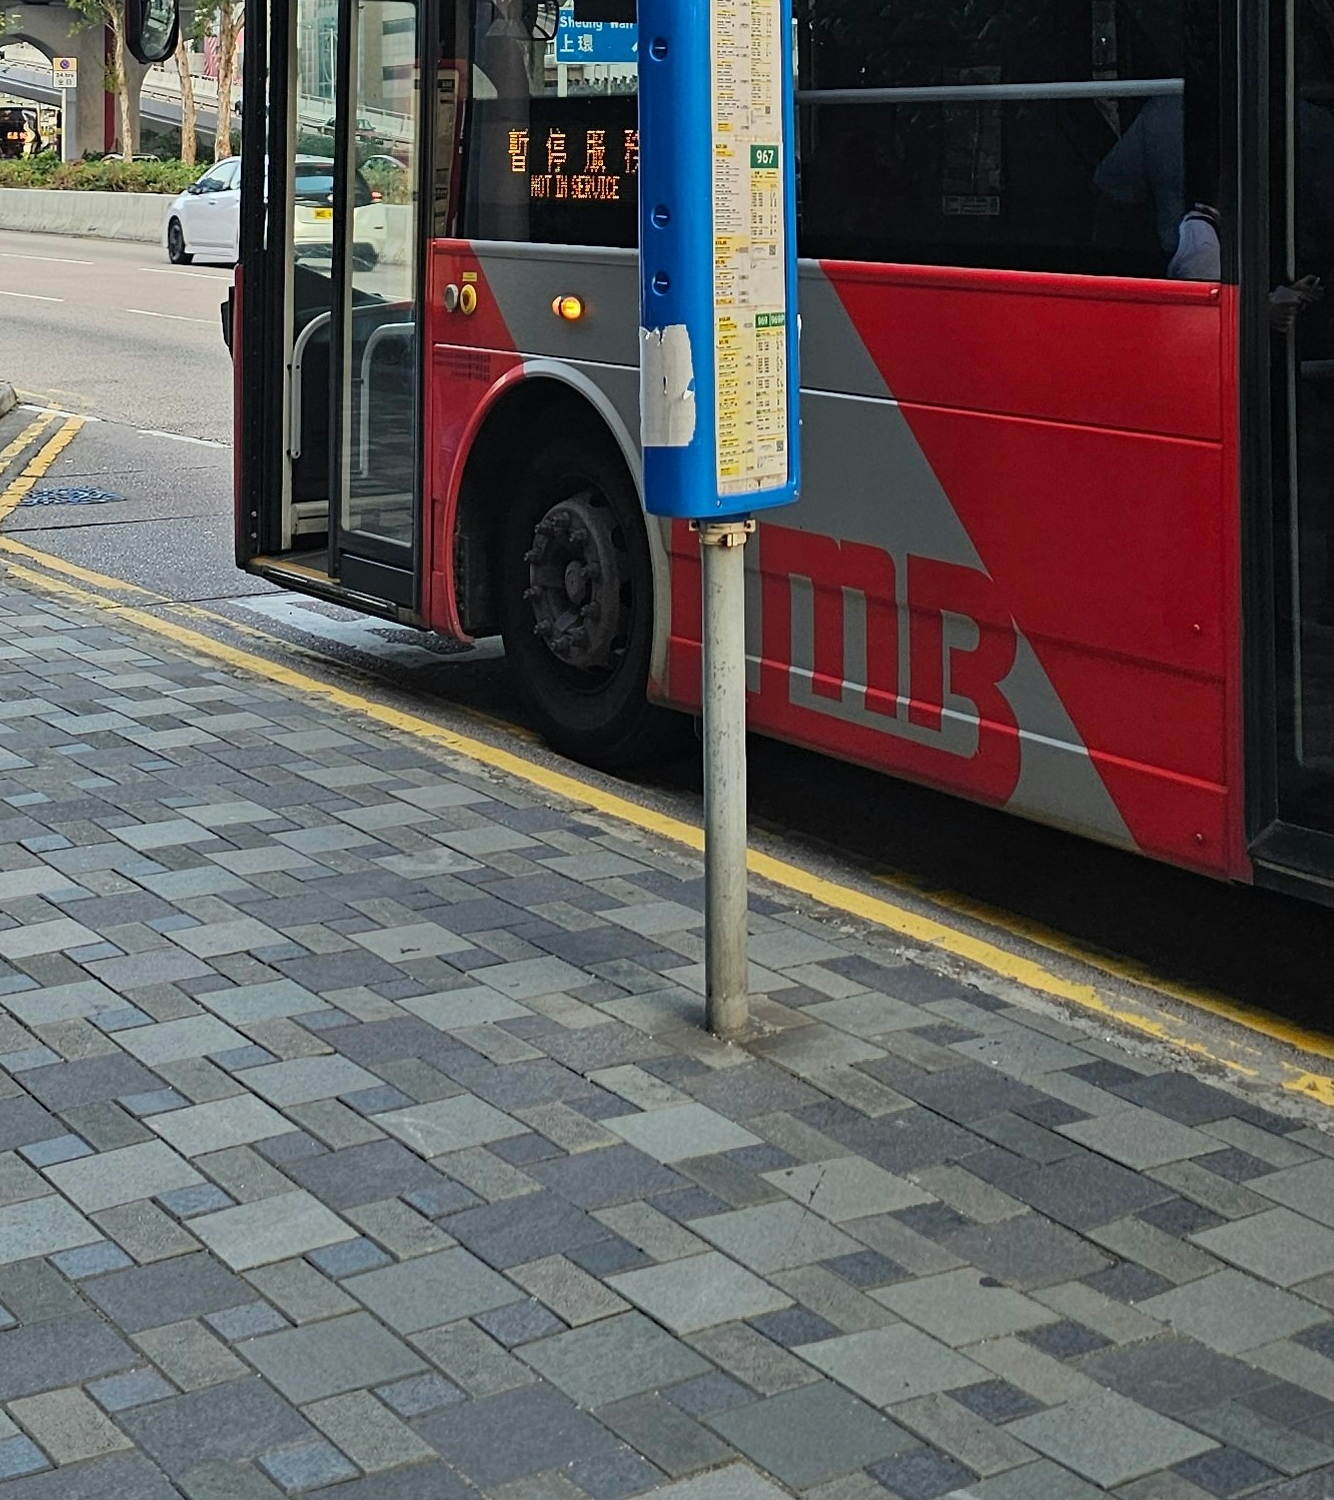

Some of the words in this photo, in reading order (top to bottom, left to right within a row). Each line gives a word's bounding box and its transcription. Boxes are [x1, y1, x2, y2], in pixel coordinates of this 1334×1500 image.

[756, 150, 774, 164] 967
[531, 175, 552, 197] NOT
[555, 175, 567, 197] IN
[571, 175, 620, 199] SERVICE
